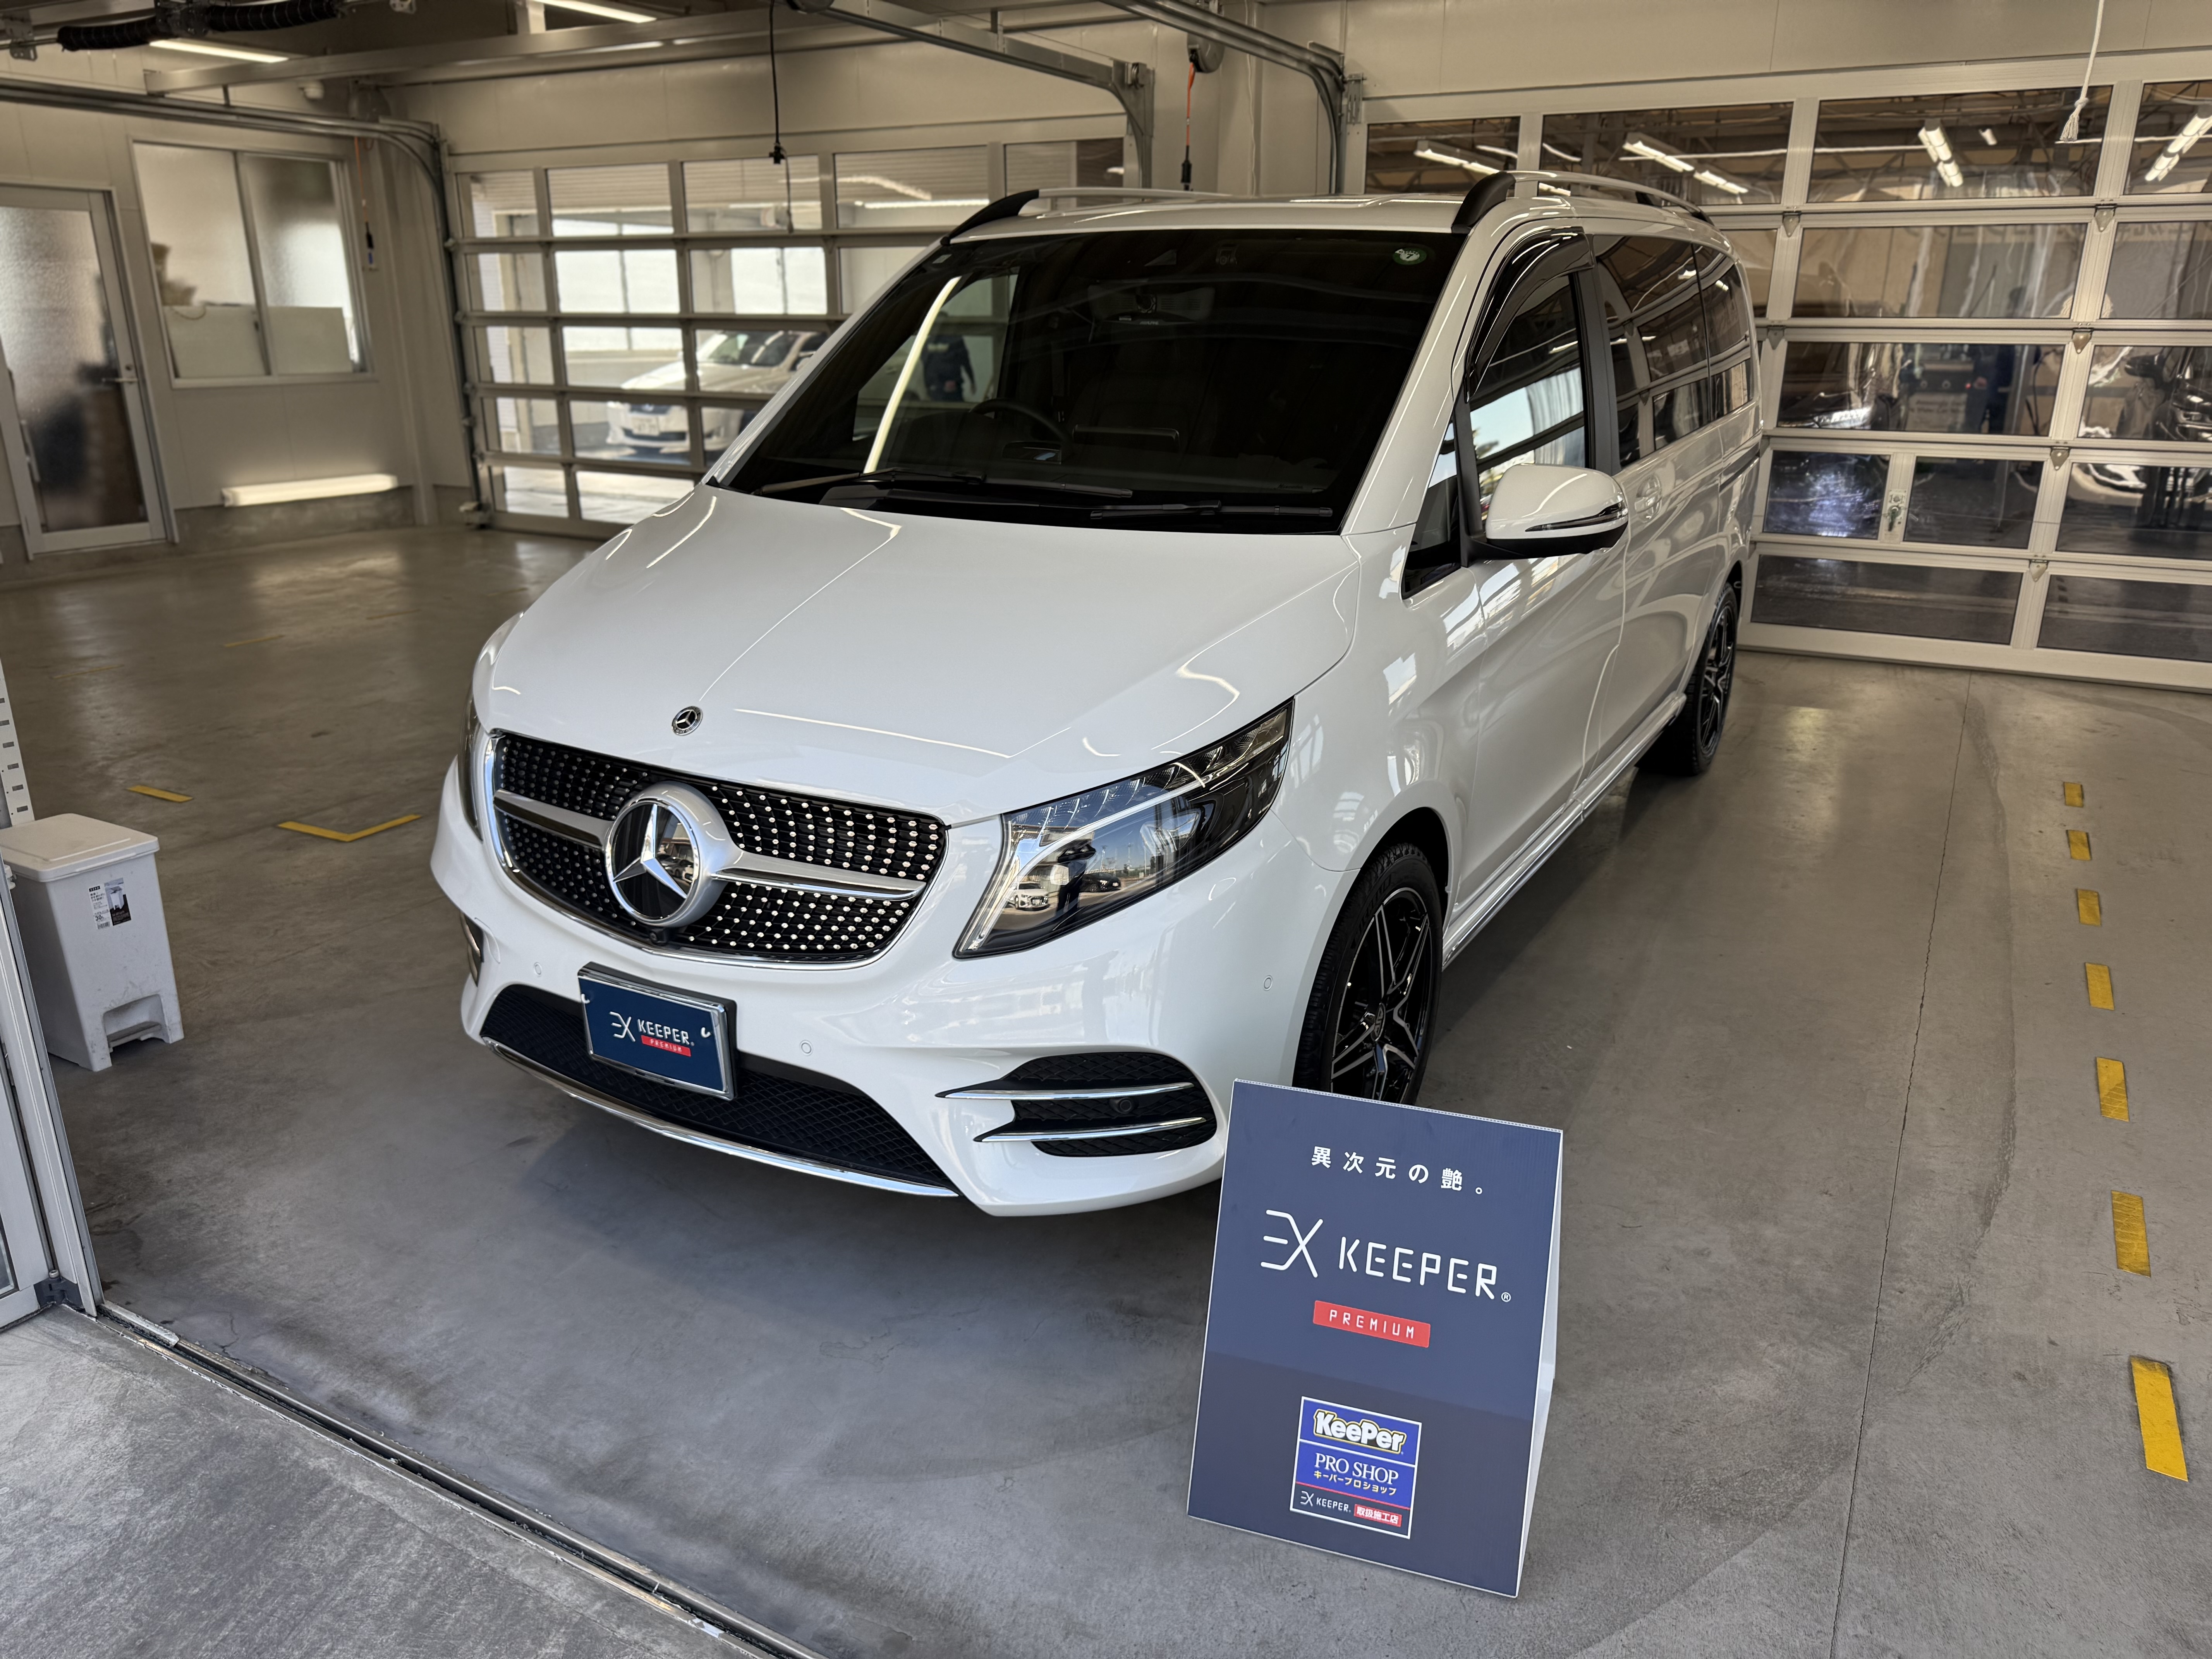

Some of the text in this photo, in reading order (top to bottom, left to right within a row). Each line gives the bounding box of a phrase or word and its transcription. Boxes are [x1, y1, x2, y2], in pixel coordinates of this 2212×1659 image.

[650, 1039, 682, 1052] PREMIUM
[1312, 1146, 1482, 1194] 異次元の艶。
[1329, 1309, 1415, 1339] PREMIUM
[1314, 1410, 1406, 1453] KeePer
[1314, 1453, 1399, 1484] PRO SHOP
[1357, 1506, 1399, 1525] 取扱施工店
